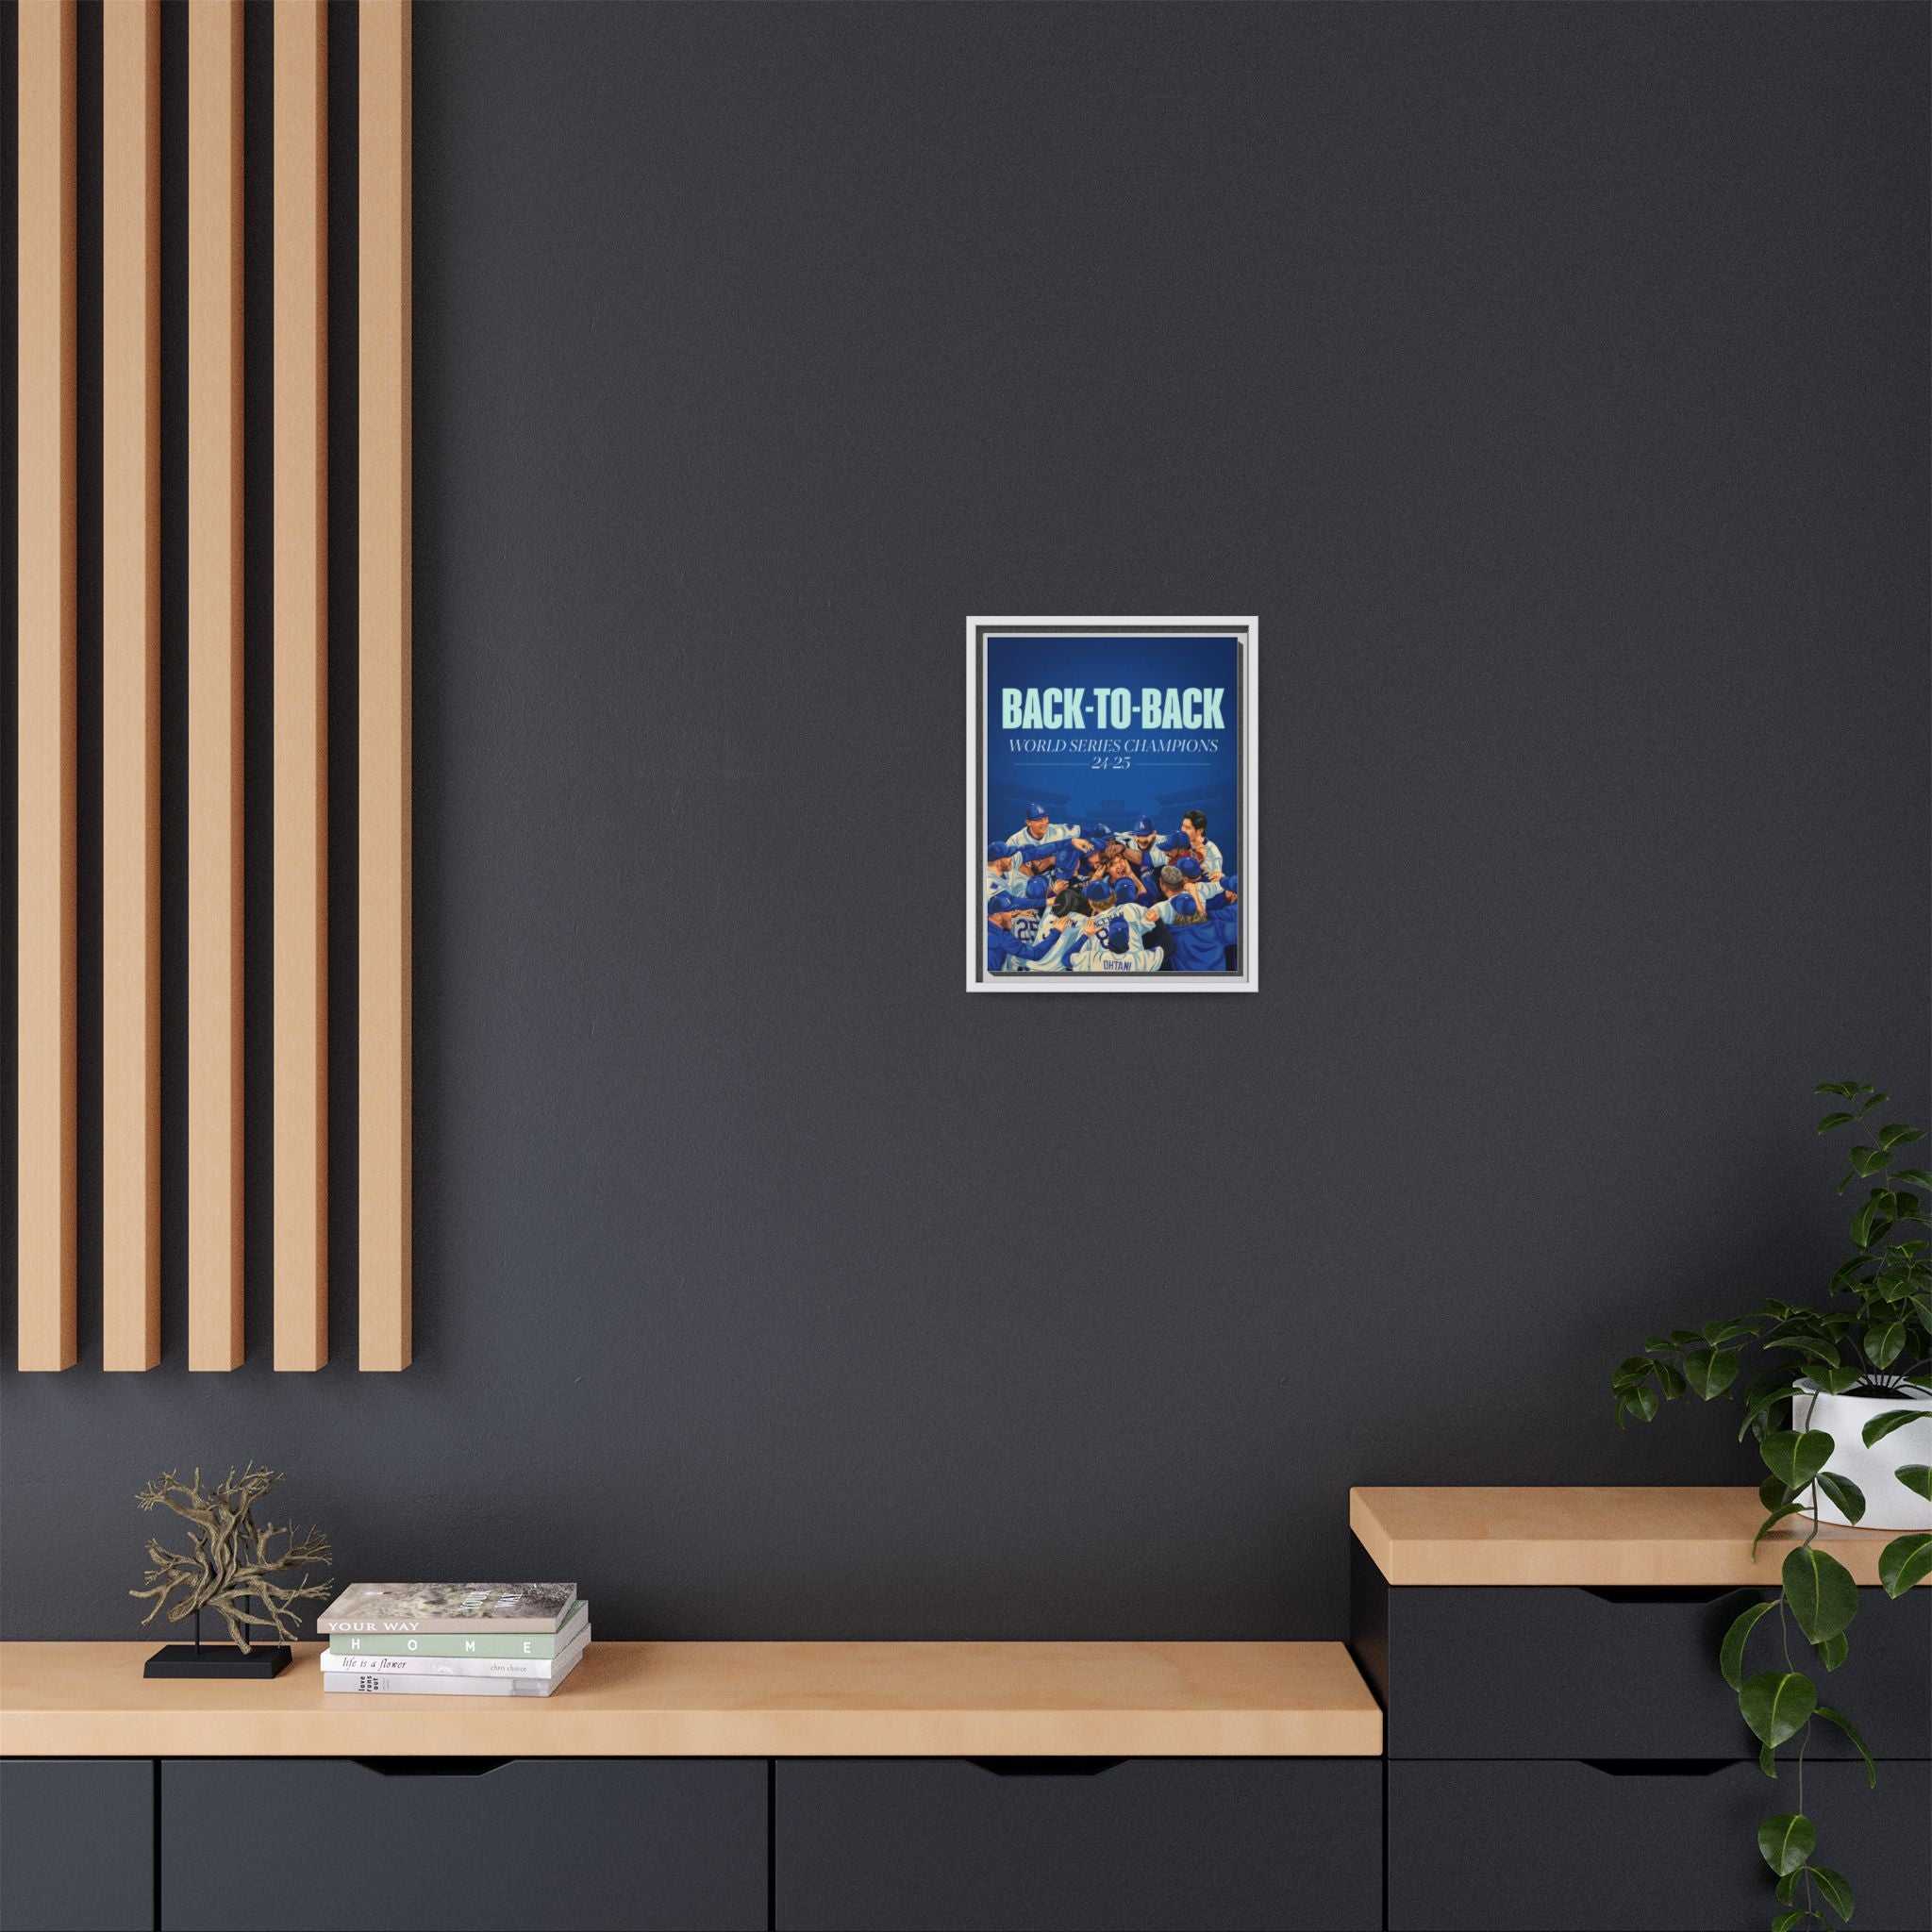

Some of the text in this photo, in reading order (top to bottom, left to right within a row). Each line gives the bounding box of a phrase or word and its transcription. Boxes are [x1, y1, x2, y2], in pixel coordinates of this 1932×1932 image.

[1002, 688, 1225, 729] BACK-TO-BACK
[1009, 740, 1219, 753] WORLD SERIES CHAMPIONS
[1103, 960, 1132, 971] OHTANI
[328, 1623, 421, 1631] YOUR WAY
[342, 1657, 358, 1671] life
[360, 1659, 367, 1668] is
[377, 1658, 407, 1671] flower
